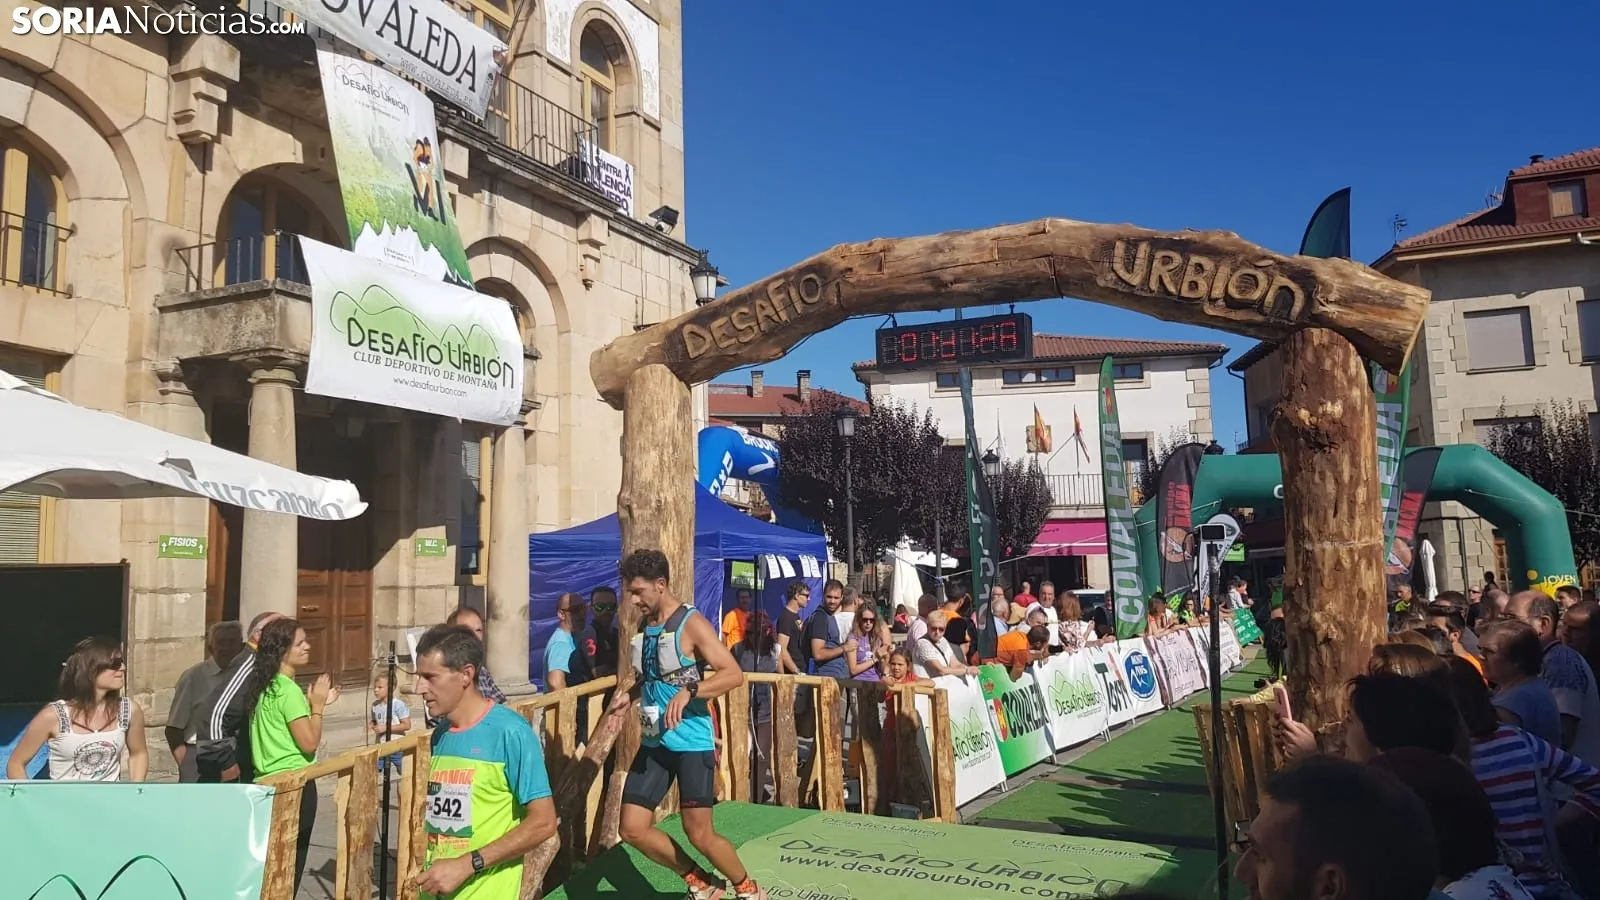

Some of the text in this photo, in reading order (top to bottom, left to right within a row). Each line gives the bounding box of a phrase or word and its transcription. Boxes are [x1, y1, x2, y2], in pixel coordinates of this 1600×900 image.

[320, 0, 476, 93] VALEDA
[353, 351, 499, 390] CLUB DEPORTIVO DE MONTAÑA
[168, 536, 198, 548] FISIOS
[1543, 573, 1577, 587] JOVEN
[433, 796, 463, 818] 542
